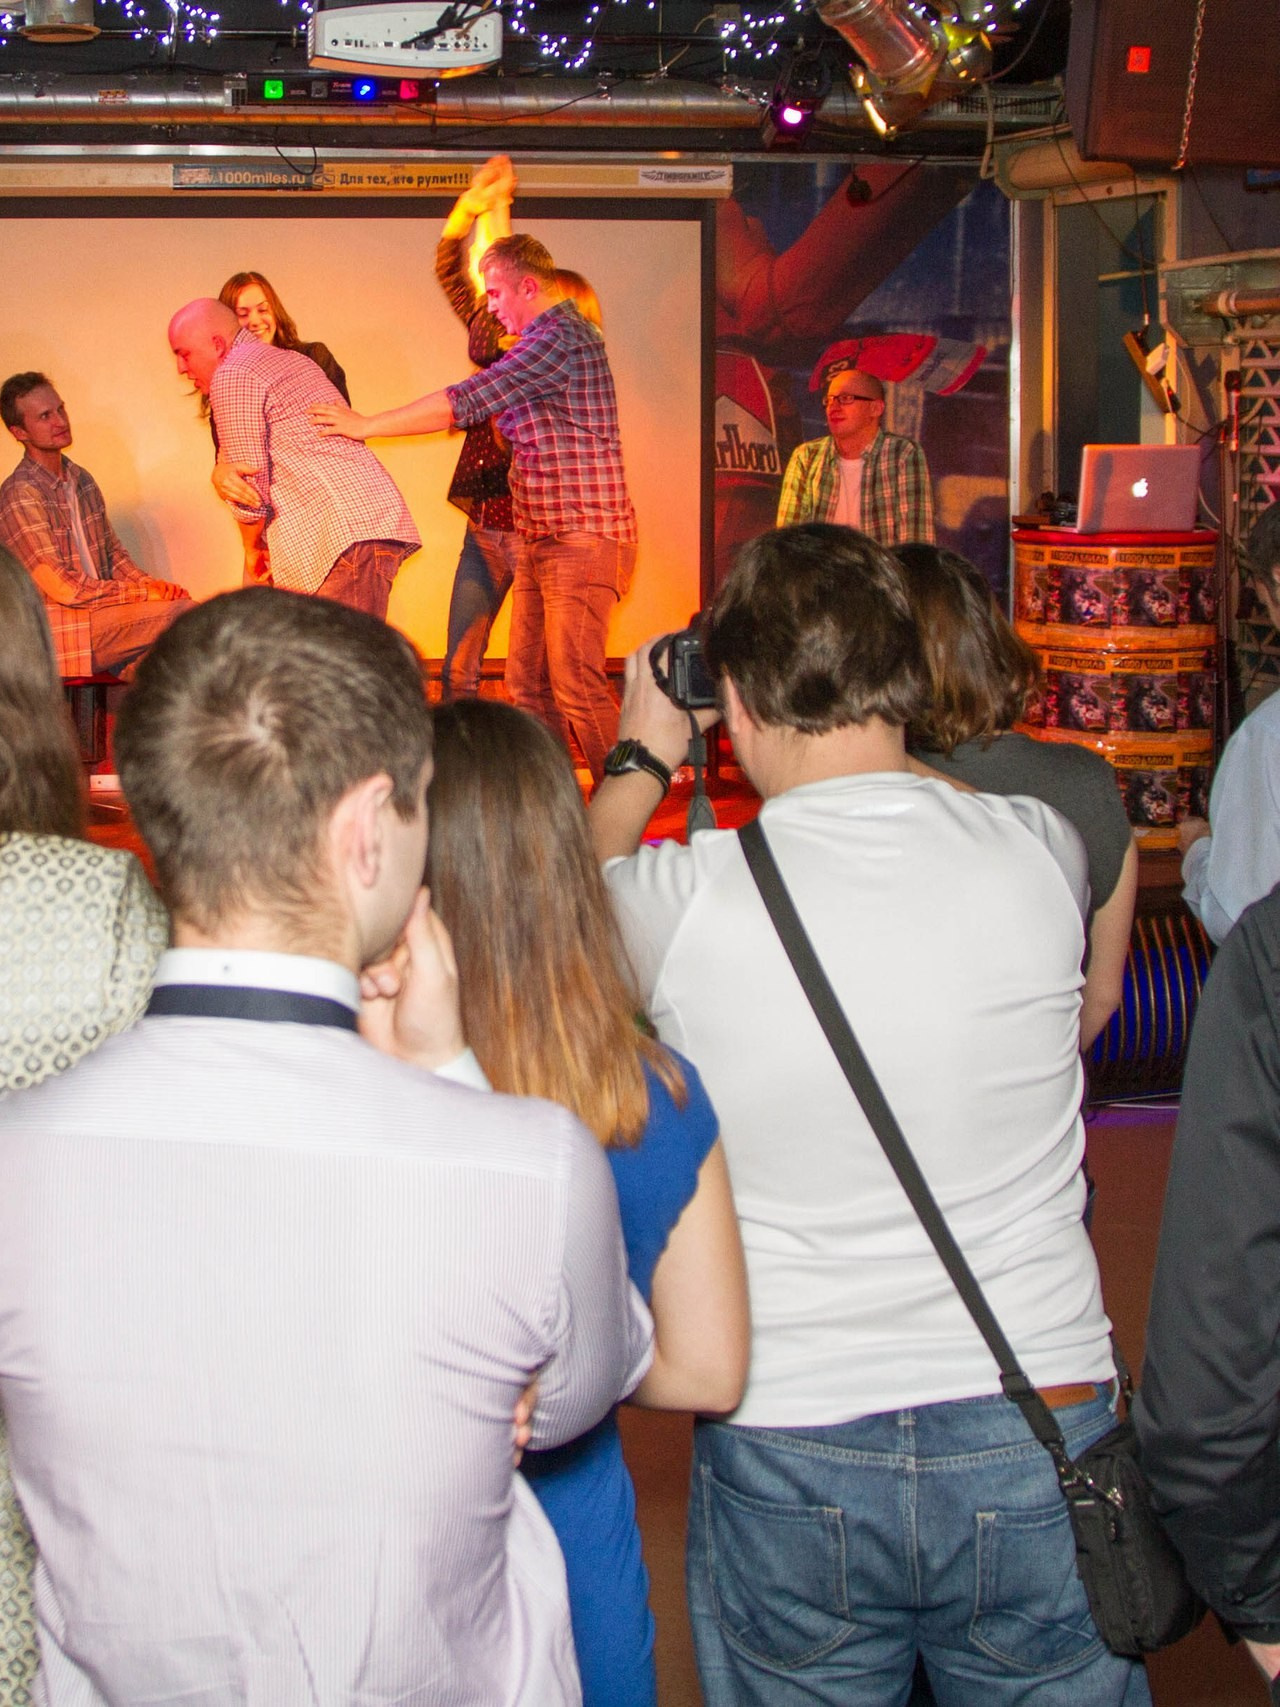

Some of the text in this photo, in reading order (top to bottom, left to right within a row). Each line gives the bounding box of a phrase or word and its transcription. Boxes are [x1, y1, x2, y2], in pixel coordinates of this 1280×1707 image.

[340, 173, 469, 187] Для тех, кто рулит!!!
